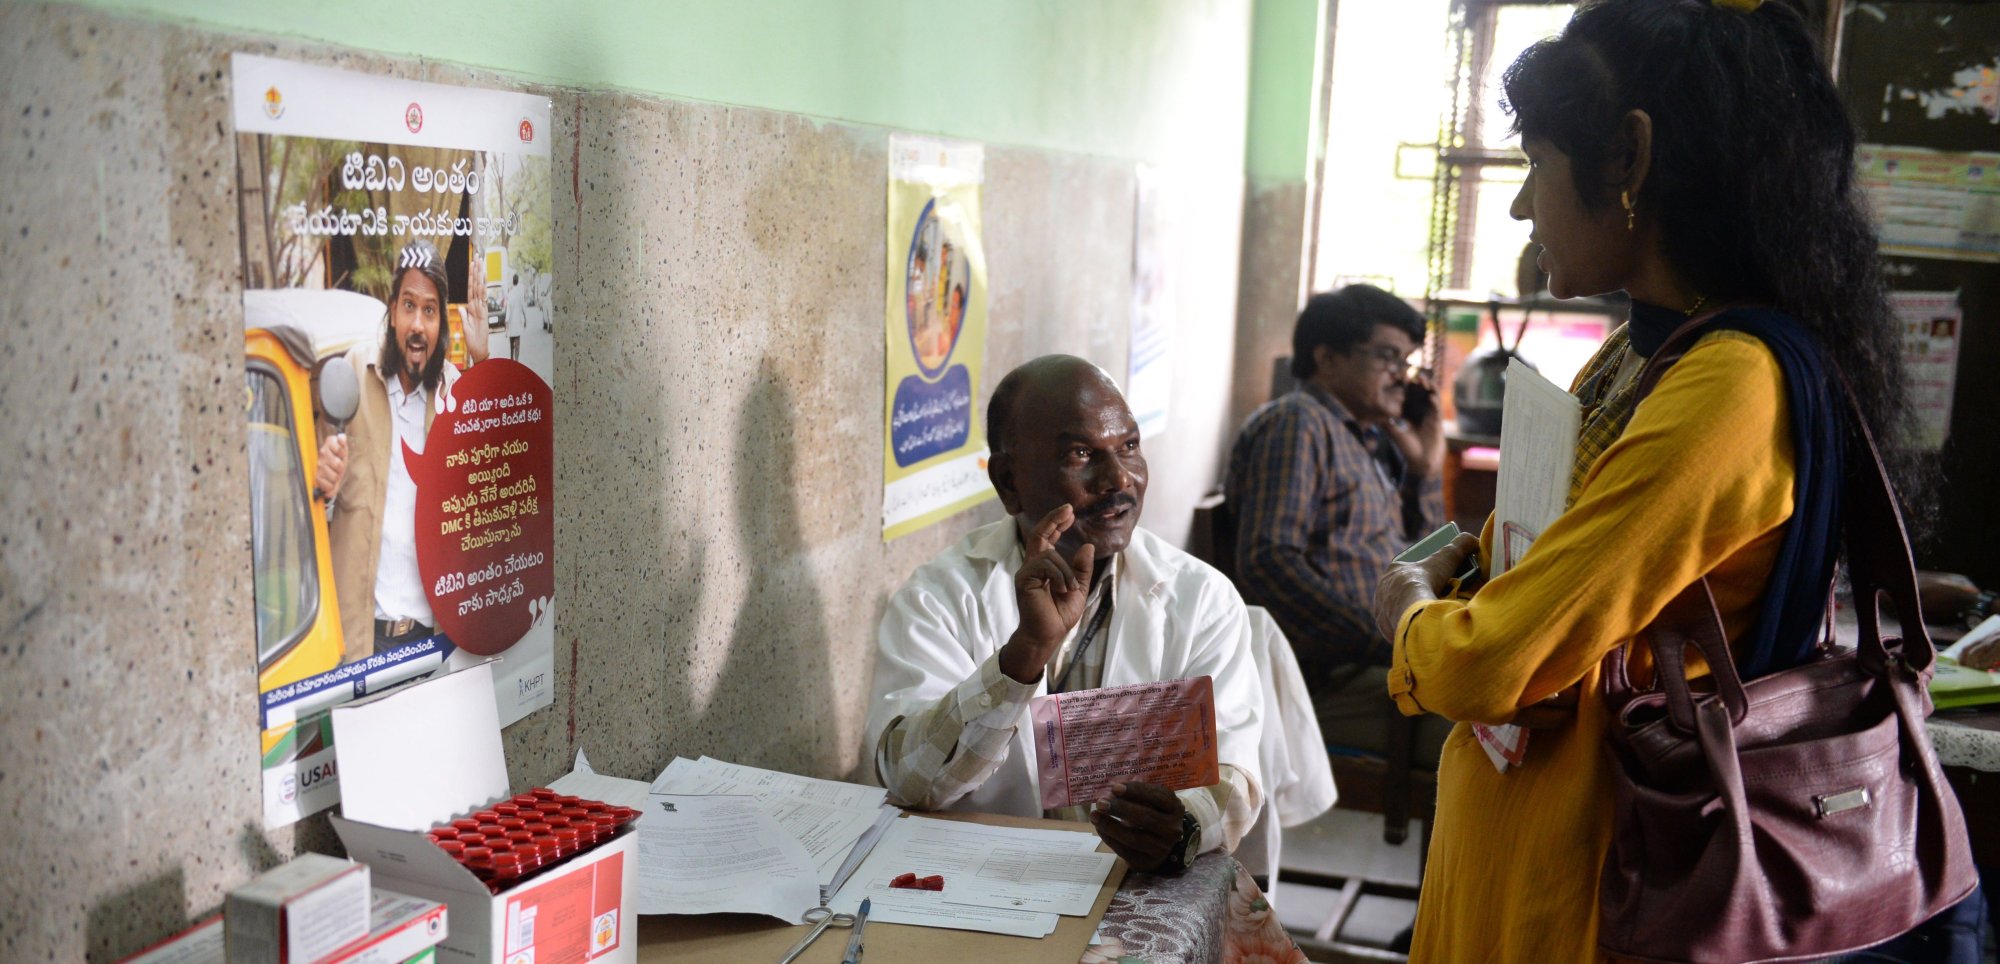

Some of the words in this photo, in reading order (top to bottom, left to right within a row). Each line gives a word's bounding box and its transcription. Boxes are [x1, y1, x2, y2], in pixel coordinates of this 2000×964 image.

[342, 151, 405, 191] టిబిని
[411, 158, 480, 195] అంతం
[291, 201, 388, 236] చేయటానికి
[392, 208, 472, 236] నాయకులు
[462, 399, 477, 414] టిబి
[500, 394, 514, 408] అది
[516, 392, 527, 406] ఒక
[454, 417, 500, 435] సంవత్సరాల
[502, 409, 526, 426] కిందటి
[446, 449, 468, 468] నాకు
[471, 443, 500, 465] పూర్తిగా
[501, 439, 529, 457] నయం
[468, 462, 510, 485] అయ్యింది
[442, 491, 477, 514] ఇప్పుడు
[480, 483, 498, 504] నేనే
[499, 474, 536, 499] అందరినీ
[441, 518, 463, 535] DMC
[465, 513, 471, 529] కి
[519, 495, 539, 515] పరీక్ష
[461, 522, 522, 551] చేయిస్తున్నాను
[435, 572, 465, 597] టిబిని
[467, 562, 502, 586] అంతం
[504, 552, 543, 575] చేయటం
[458, 593, 483, 616] నాకు
[485, 578, 524, 607] సాధ్యమే
[525, 673, 544, 692] KHPT
[301, 760, 336, 787] USAI
